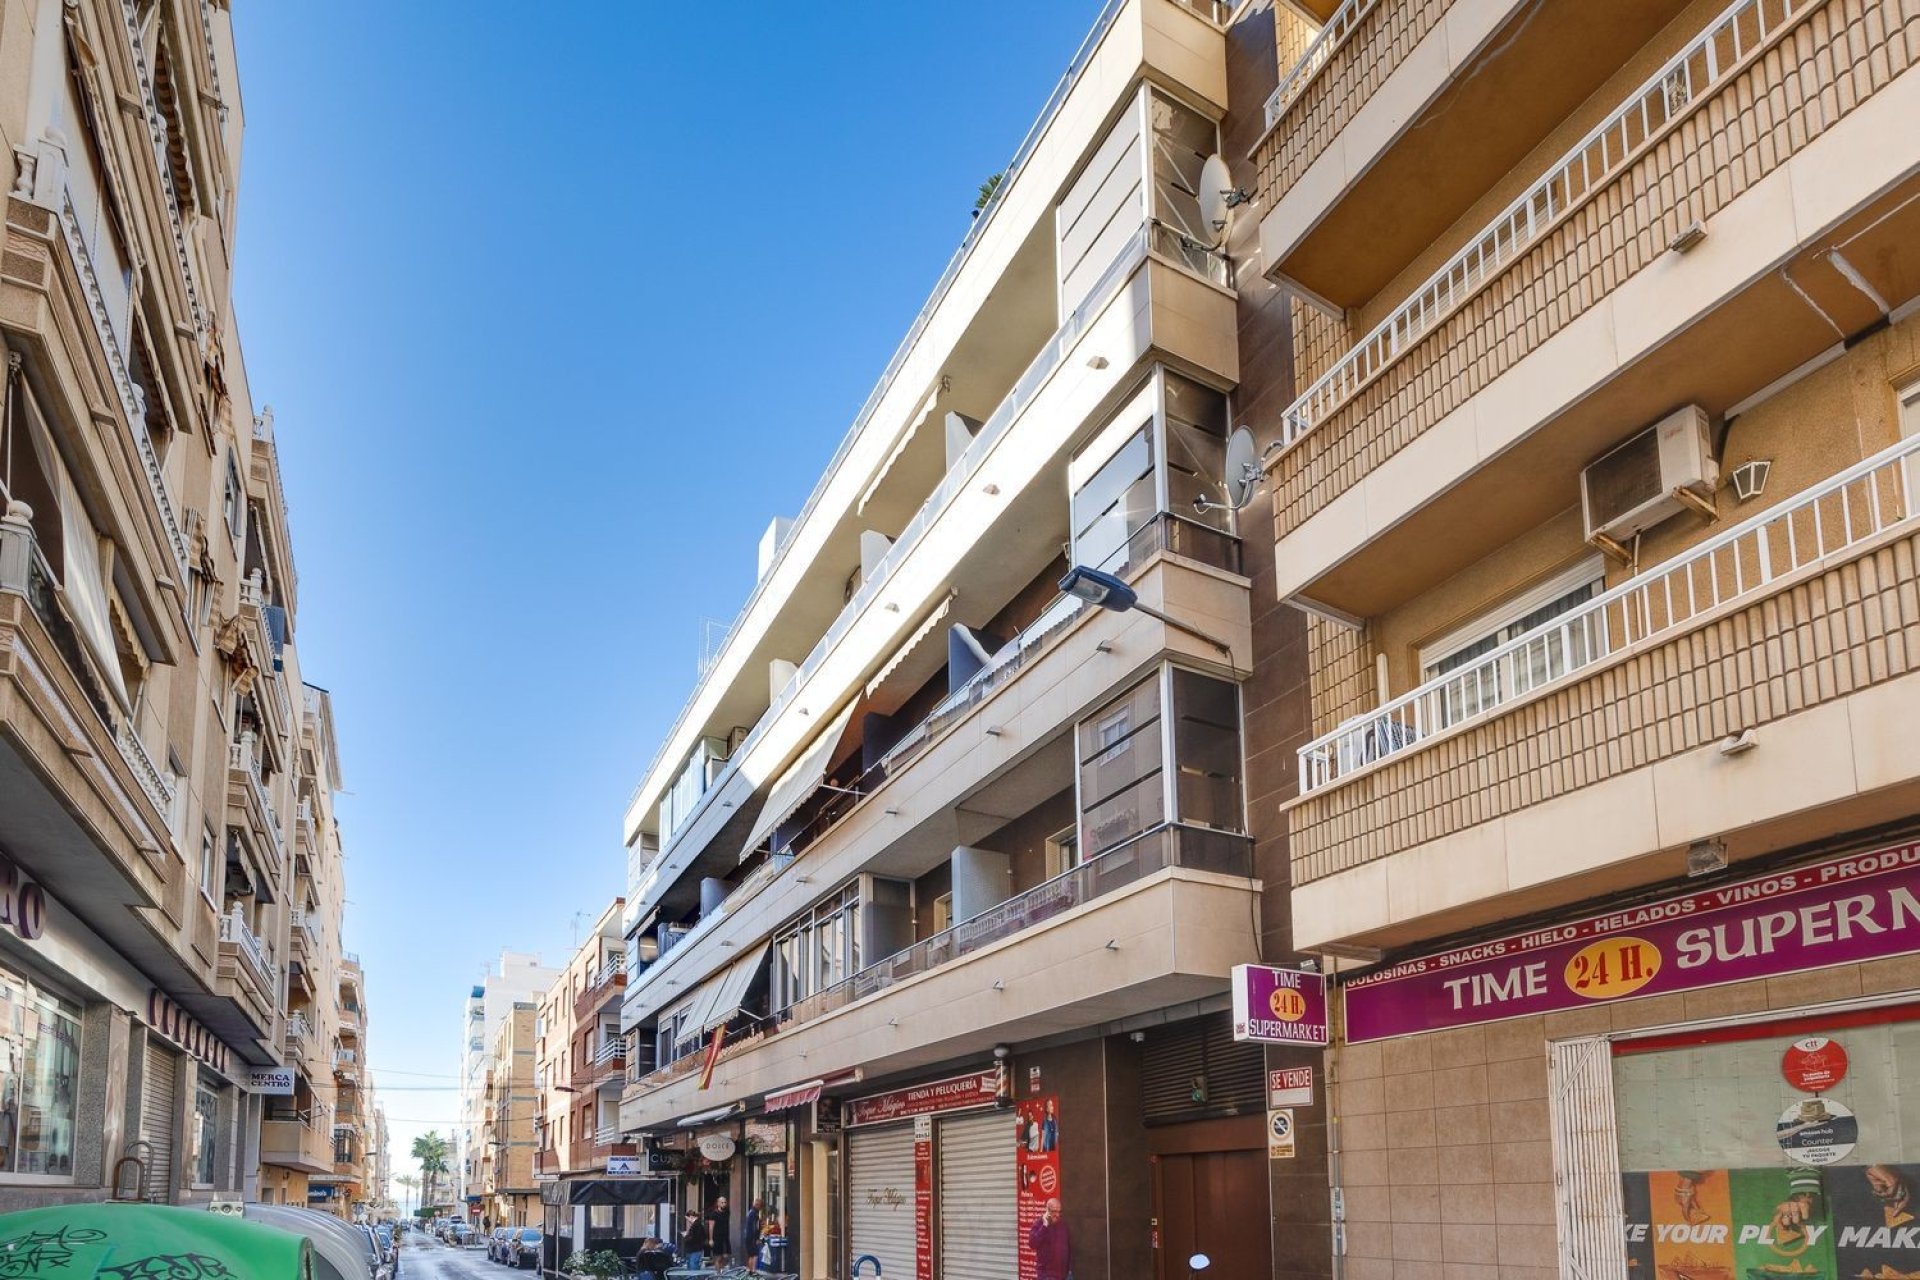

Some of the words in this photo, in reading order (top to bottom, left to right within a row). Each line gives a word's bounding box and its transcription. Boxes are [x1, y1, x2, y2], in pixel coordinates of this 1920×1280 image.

[1347, 960, 1427, 988] GOLOSINAS
[1439, 941, 1507, 967] SNACKS
[1521, 926, 1577, 950] HIELO
[1594, 899, 1697, 933] HELADOS
[1716, 875, 1797, 905] VINOS
[1271, 970, 1302, 989] TIME
[1443, 961, 1548, 1011] TIME
[1574, 951, 1609, 990] 24
[1620, 944, 1655, 982] H.
[1274, 993, 1288, 1013] 24
[1249, 1018, 1326, 1042] SUPERMARKET
[1805, 1040, 1818, 1048] ctt
[251, 1073, 290, 1081] MERCA
[251, 1080, 290, 1088] CENTRO
[1271, 1073, 1281, 1089] SE
[1282, 1069, 1311, 1089] VENDE
[907, 1087, 930, 1101] TIENDA
[929, 1087, 935, 1097] Y
[935, 1078, 978, 1096] PELUQUERÍA
[1801, 1138, 1834, 1146] Counter
[1656, 1223, 1730, 1245] YOUR
[1738, 1223, 1829, 1246] PLY
[1837, 1226, 1920, 1249] MAK
